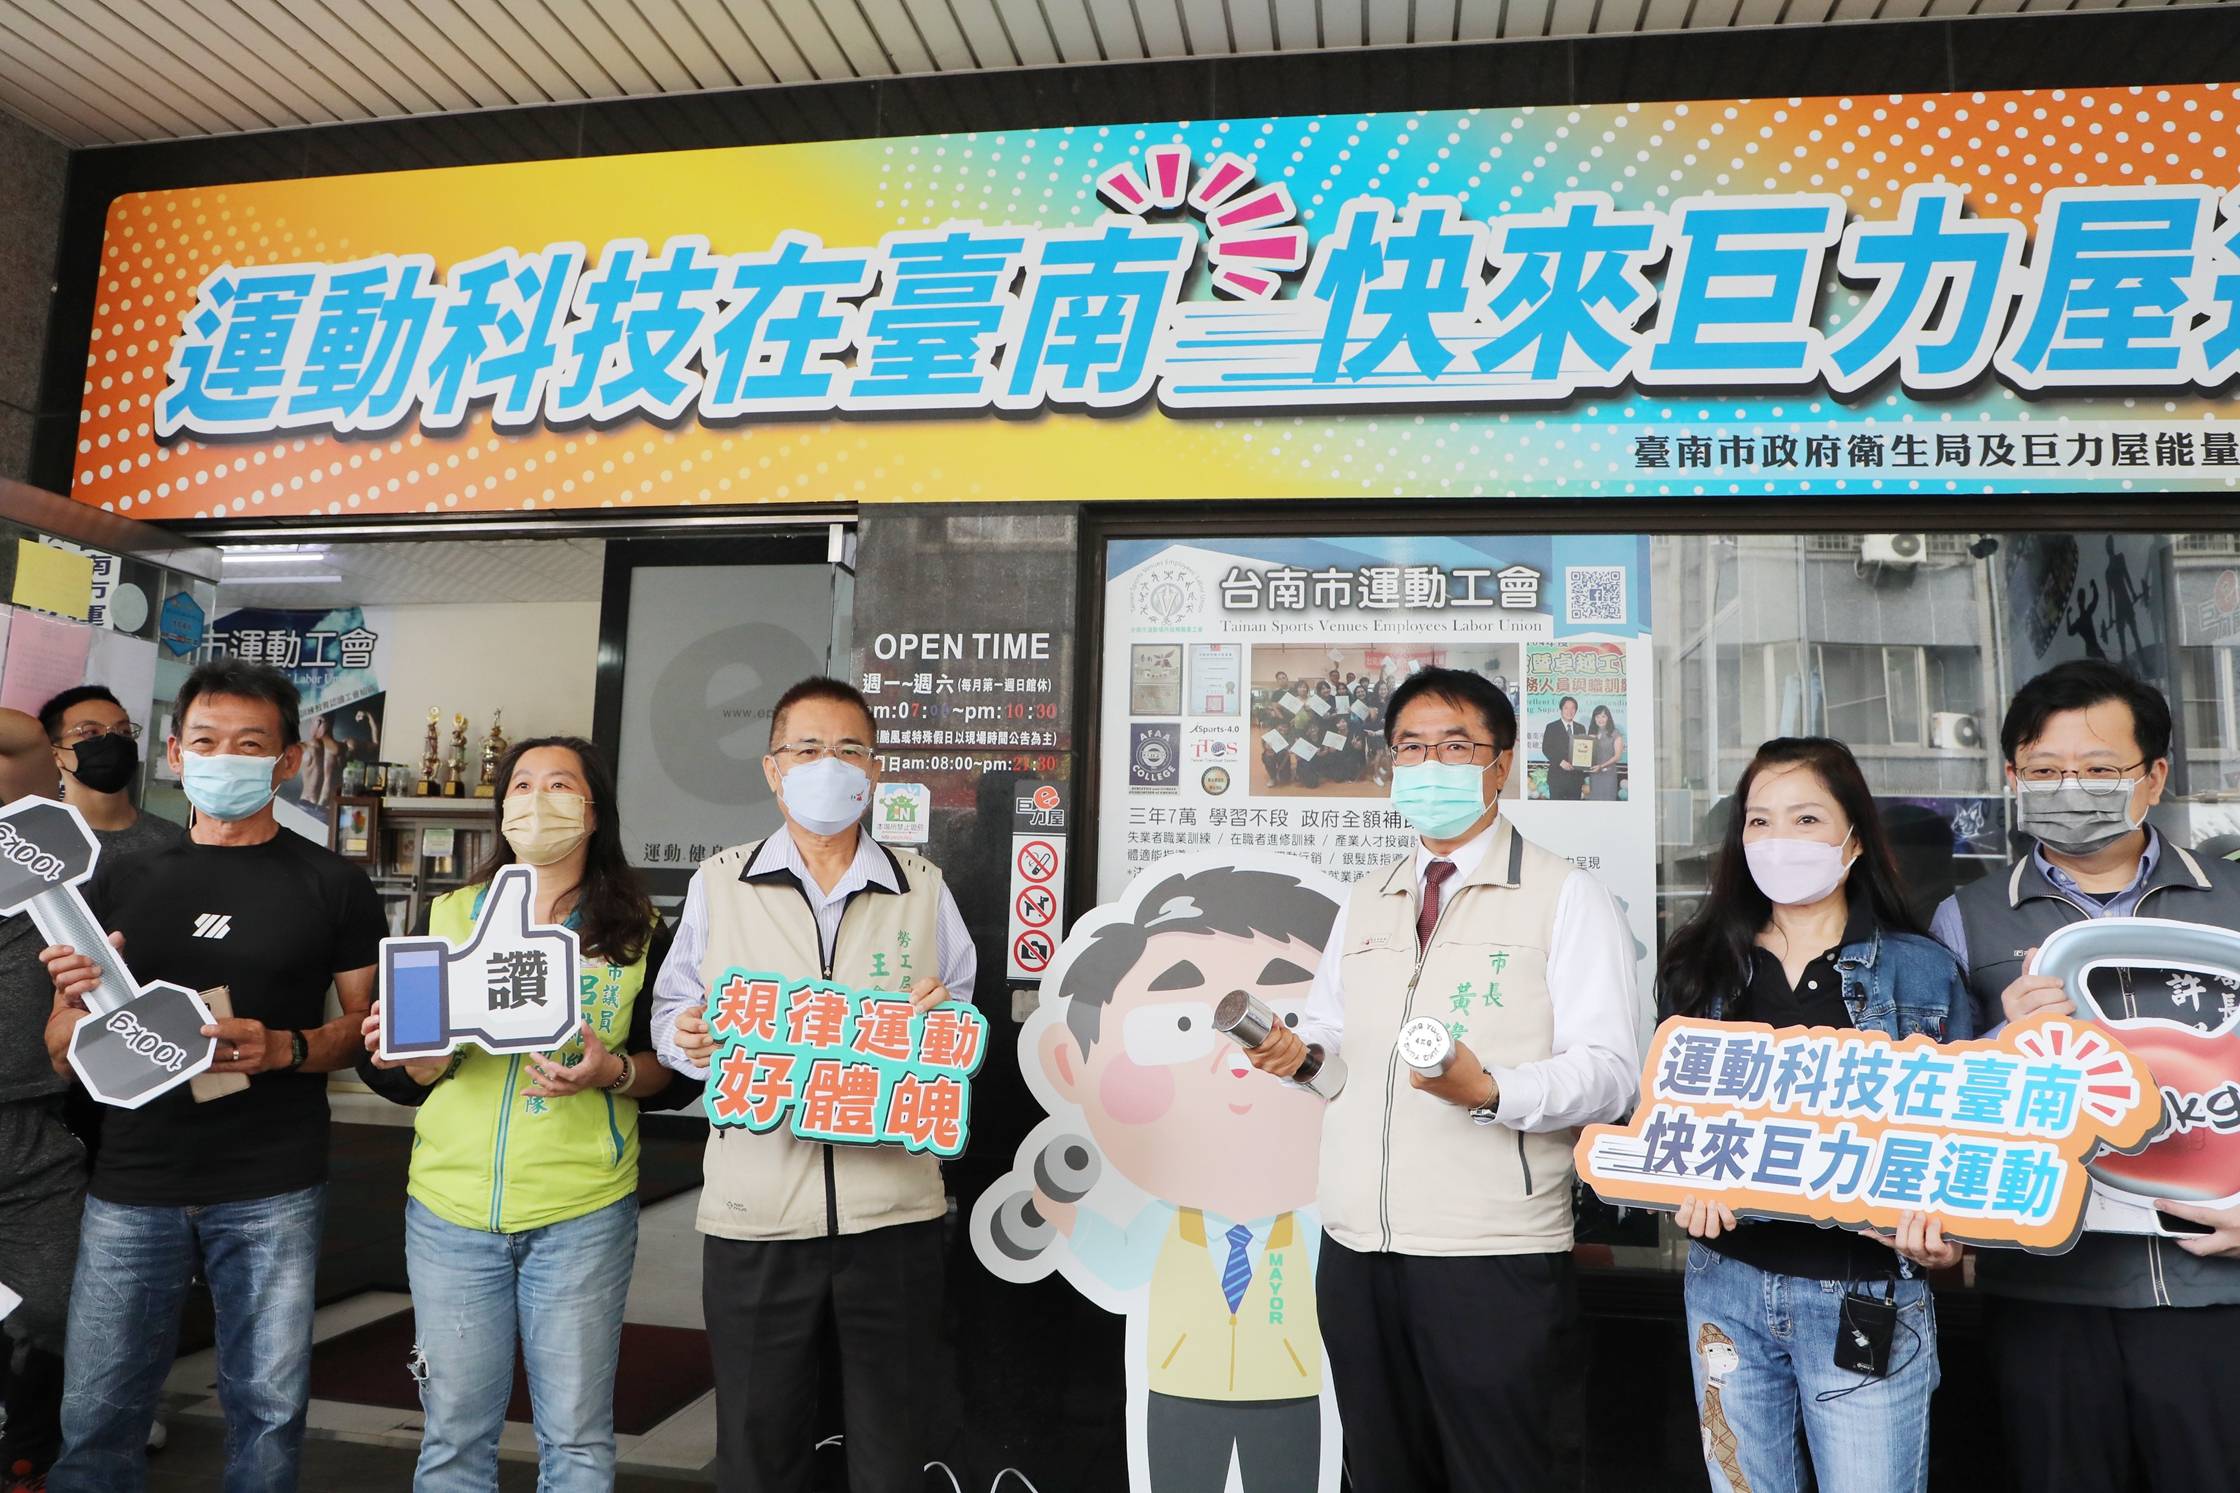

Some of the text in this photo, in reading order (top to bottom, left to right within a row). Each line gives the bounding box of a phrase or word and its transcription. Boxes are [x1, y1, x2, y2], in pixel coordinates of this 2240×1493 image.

[1310, 190, 2240, 395] 快來巨力屋
[158, 218, 1198, 432] 運動科技在臺南
[1633, 430, 2240, 469] 臺南市政府衛生局及巨力屋能量
[1219, 565, 1541, 610] 台南市運動工會
[874, 632, 1050, 660] OPEN TIME
[1220, 618, 1542, 635] Tainan Sports Venues Employees Labor Union
[1139, 729, 1171, 742] AFAA
[1132, 764, 1176, 782] COLLEGE
[1128, 807, 1197, 826] 三年7萬
[1208, 807, 1288, 828] 學習不段
[485, 949, 549, 1011] 讚
[1482, 950, 1510, 1008] 市長
[107, 1011, 187, 1071] 100kg
[712, 975, 981, 1070] 規律運動
[710, 1048, 963, 1150] 好體魄
[1657, 1031, 2083, 1132] 運動科技在臺南
[1641, 1110, 2062, 1218] 快來巨力屋運動
[1268, 1252, 1285, 1325] MAYOR
